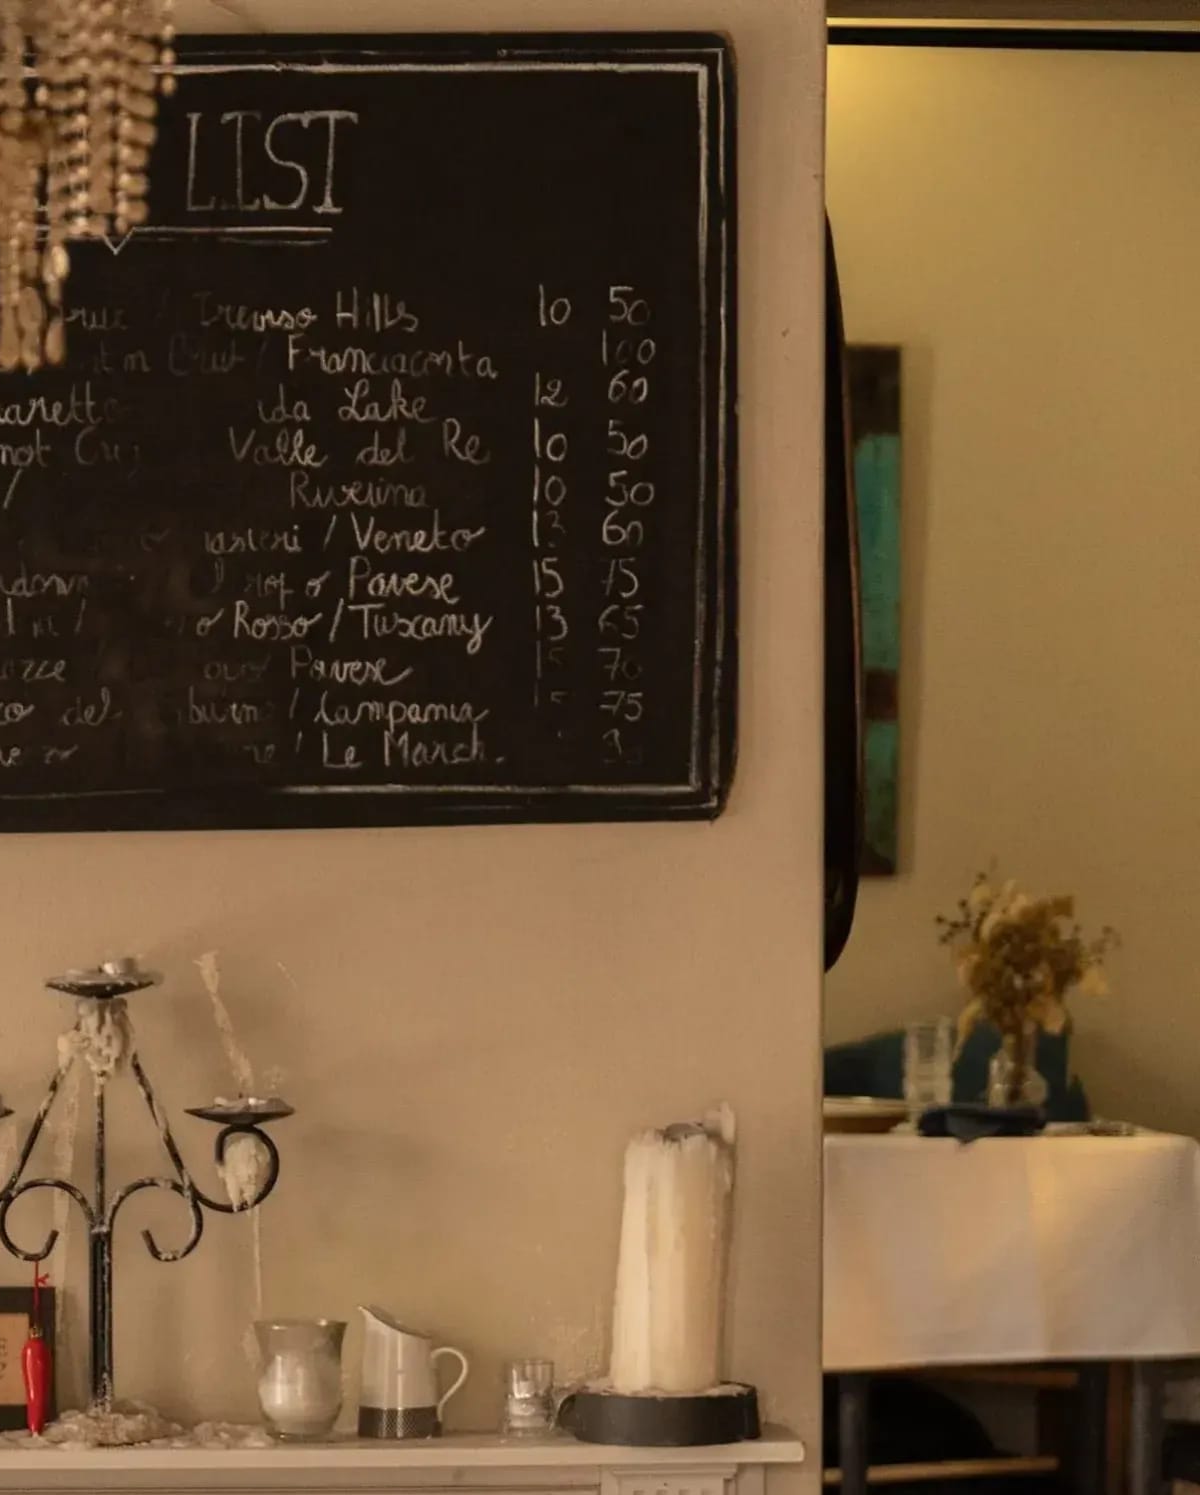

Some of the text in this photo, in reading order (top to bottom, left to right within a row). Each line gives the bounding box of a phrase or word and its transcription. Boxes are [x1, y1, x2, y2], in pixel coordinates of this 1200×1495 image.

[186, 110, 359, 214] LIST
[335, 286, 421, 334] Hills
[538, 283, 572, 328] 10
[608, 285, 651, 327] 50
[337, 378, 440, 425] Lake
[535, 371, 569, 408] 12
[608, 369, 650, 405] 60
[228, 426, 330, 468] Valle
[355, 428, 416, 468] del
[533, 416, 569, 462] 10
[606, 418, 650, 460] 50
[532, 463, 568, 507] 10
[604, 469, 655, 507] 50
[349, 508, 487, 554] Veneto
[349, 554, 462, 605] Pavese
[532, 557, 565, 599] 15
[233, 599, 324, 641] Rosso
[347, 602, 495, 656] Tuscany
[536, 604, 569, 640] 13
